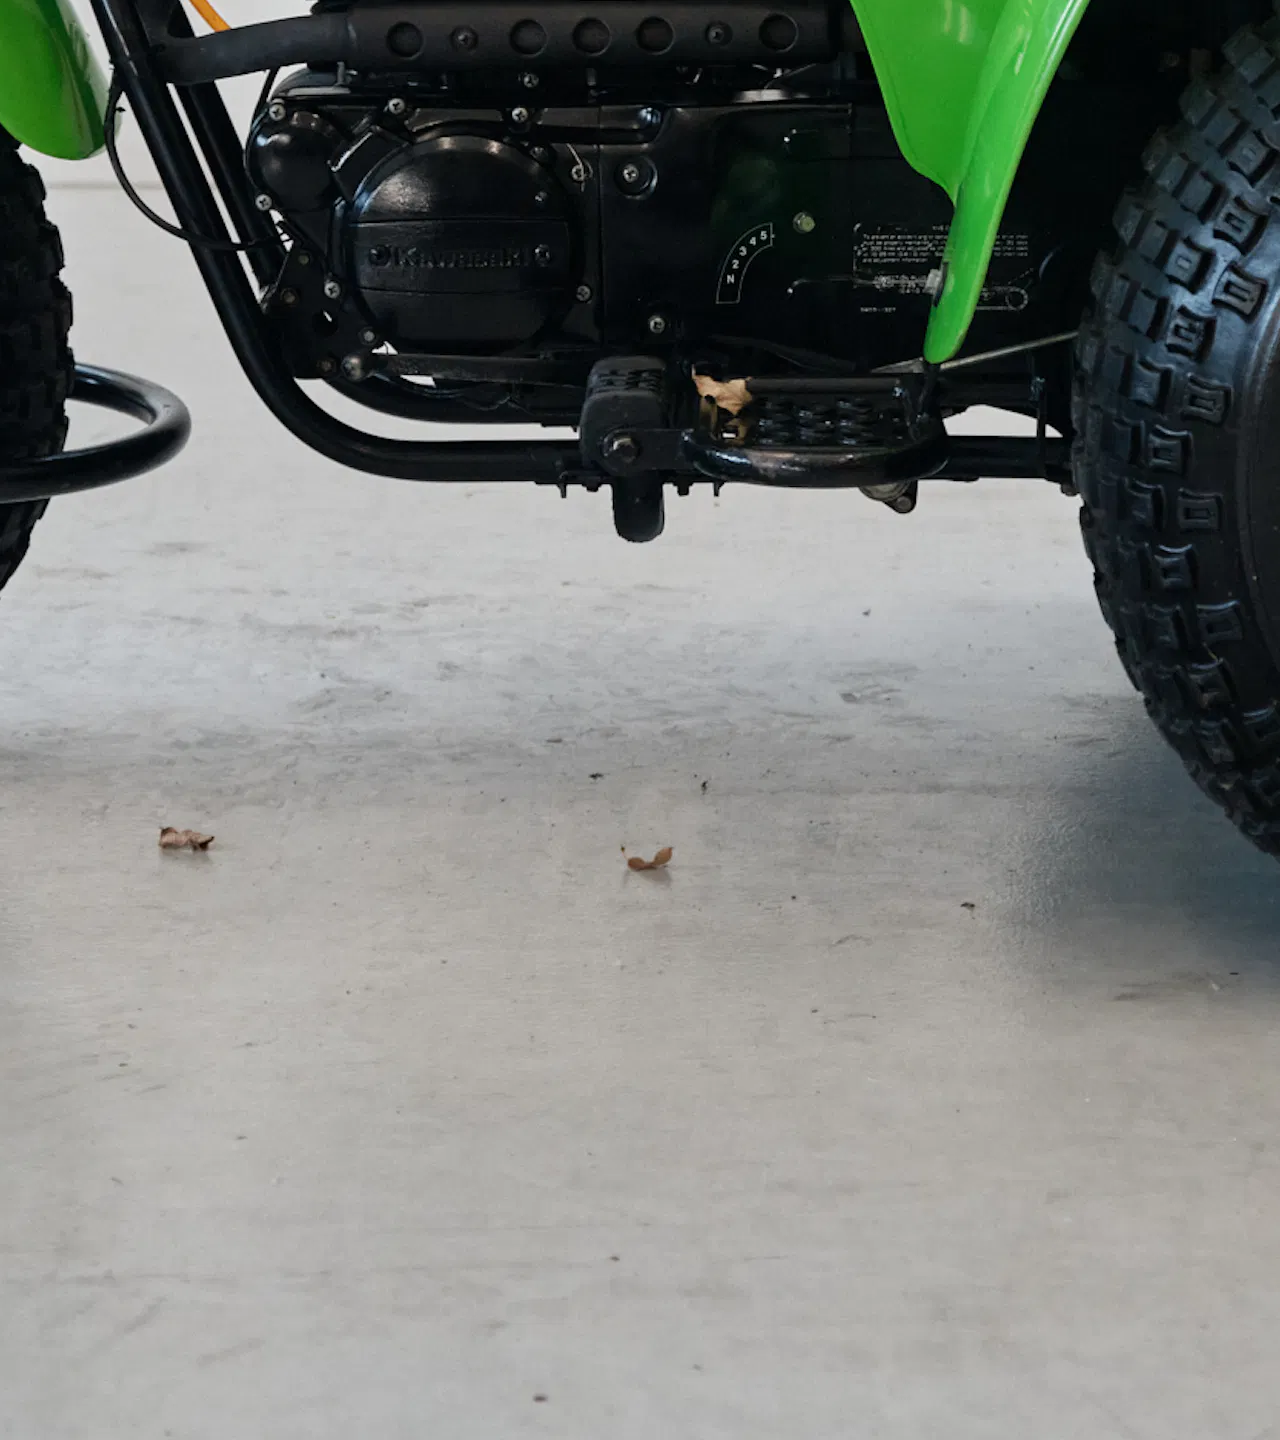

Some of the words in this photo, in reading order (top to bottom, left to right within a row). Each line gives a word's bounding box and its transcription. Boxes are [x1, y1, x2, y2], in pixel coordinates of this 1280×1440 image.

[748, 236, 757, 246] 4
[759, 230, 768, 241] 5
[738, 245, 748, 257] 3
[731, 259, 740, 270] 2
[726, 273, 735, 284] N
